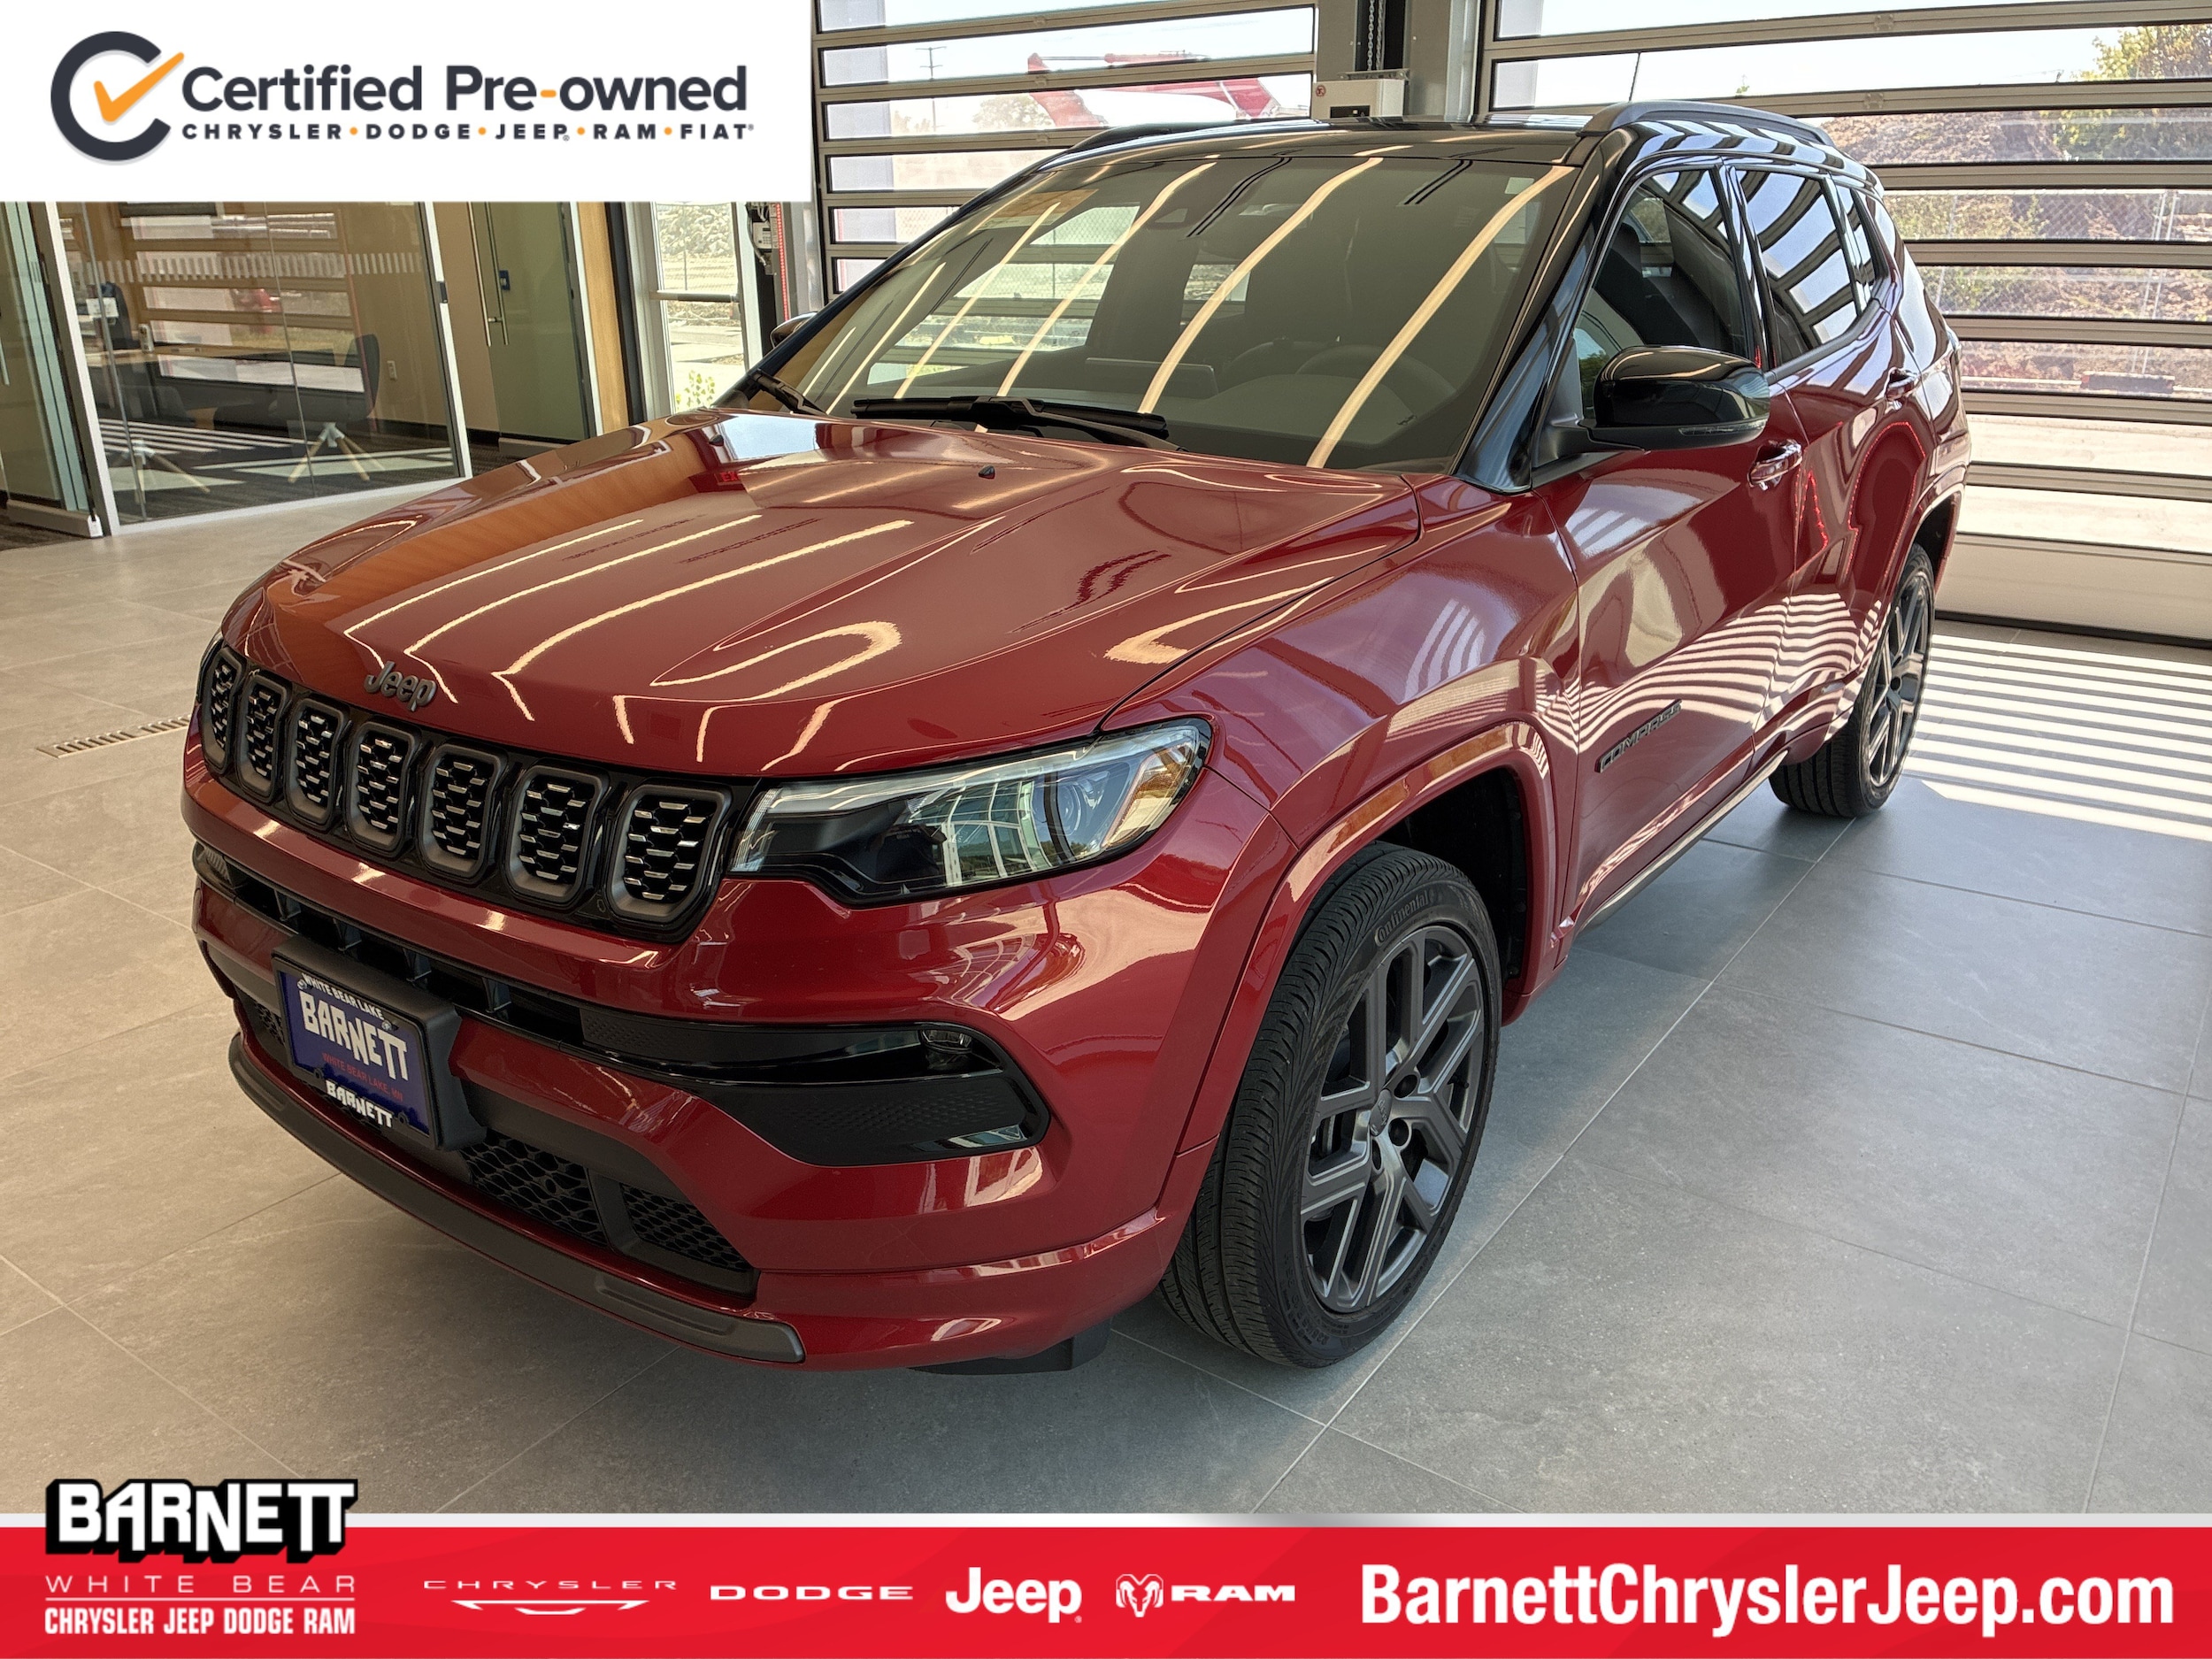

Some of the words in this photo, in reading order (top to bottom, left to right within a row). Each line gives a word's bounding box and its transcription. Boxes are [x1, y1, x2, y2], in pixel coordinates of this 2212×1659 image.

[364, 660, 437, 712] Jeep
[1374, 889, 1431, 948] Continental
[301, 972, 334, 997] WHITE
[331, 987, 358, 1009] BEAR
[357, 999, 385, 1021] LAKE
[298, 989, 409, 1081] BARNETT
[322, 1052, 347, 1072] WHITE
[346, 1064, 368, 1082] BEAR
[325, 1079, 394, 1129] BARNETT
